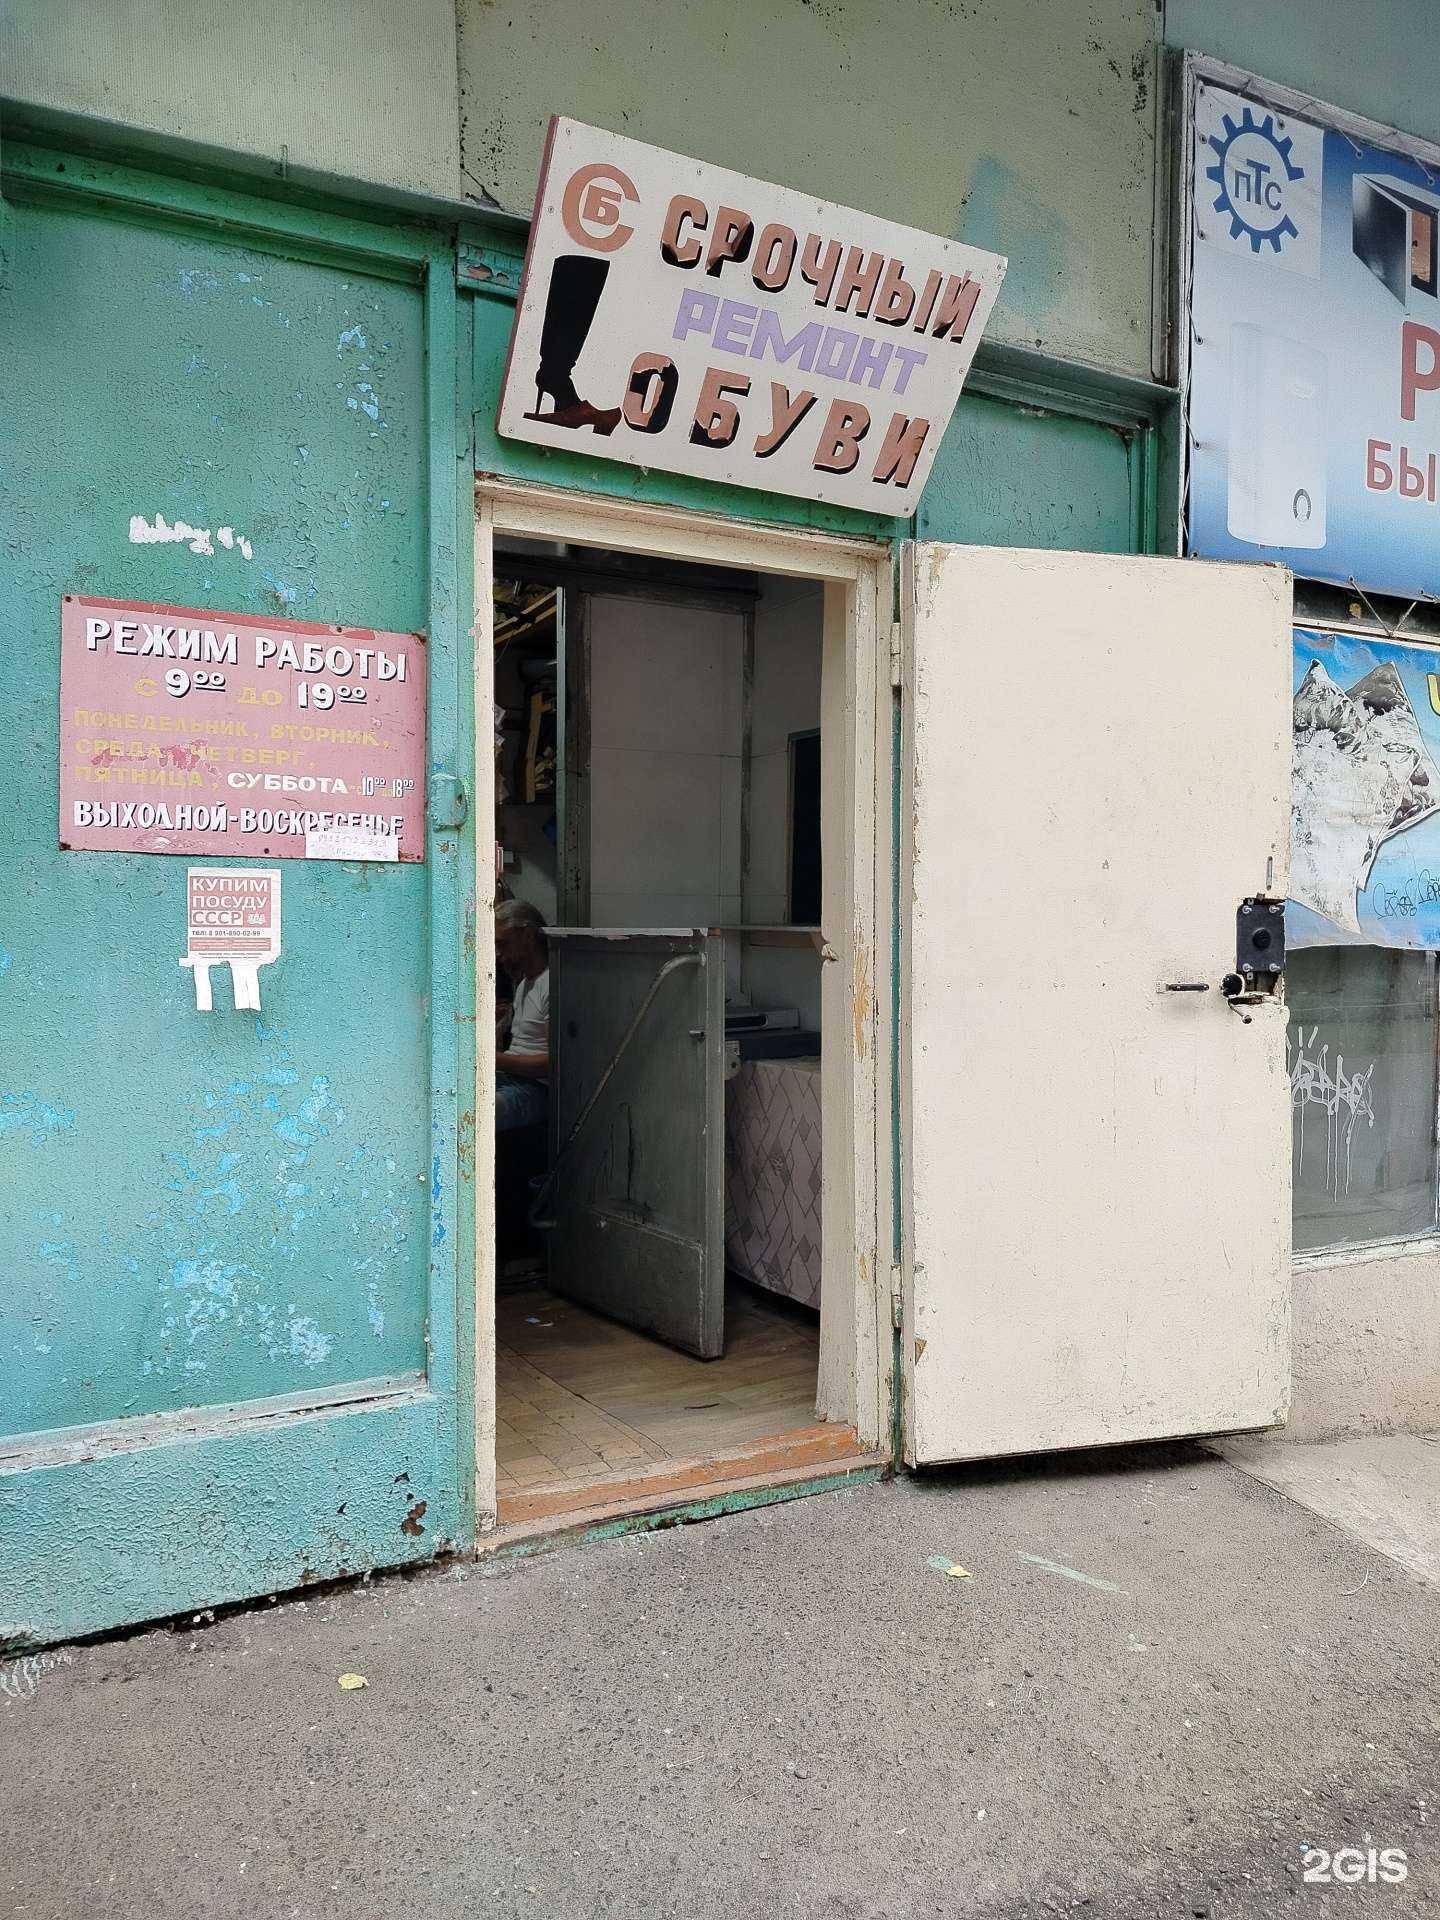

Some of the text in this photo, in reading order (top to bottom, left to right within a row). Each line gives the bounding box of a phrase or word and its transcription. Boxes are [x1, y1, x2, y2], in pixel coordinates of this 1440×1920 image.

[660, 194, 982, 344] СРОЧНЫЙ
[672, 288, 929, 395] РЕМОНТ
[622, 351, 930, 488] ОБУВИ
[86, 618, 406, 682] РЕЖИМ РАБОТЫ
[73, 710, 260, 740] ПОНЕДЕЛЬНИК,
[227, 772, 350, 795] СУББОТА
[192, 878, 268, 892] КУПИМ
[192, 895, 267, 910] ПОСУДУ
[192, 911, 242, 925] СССР
